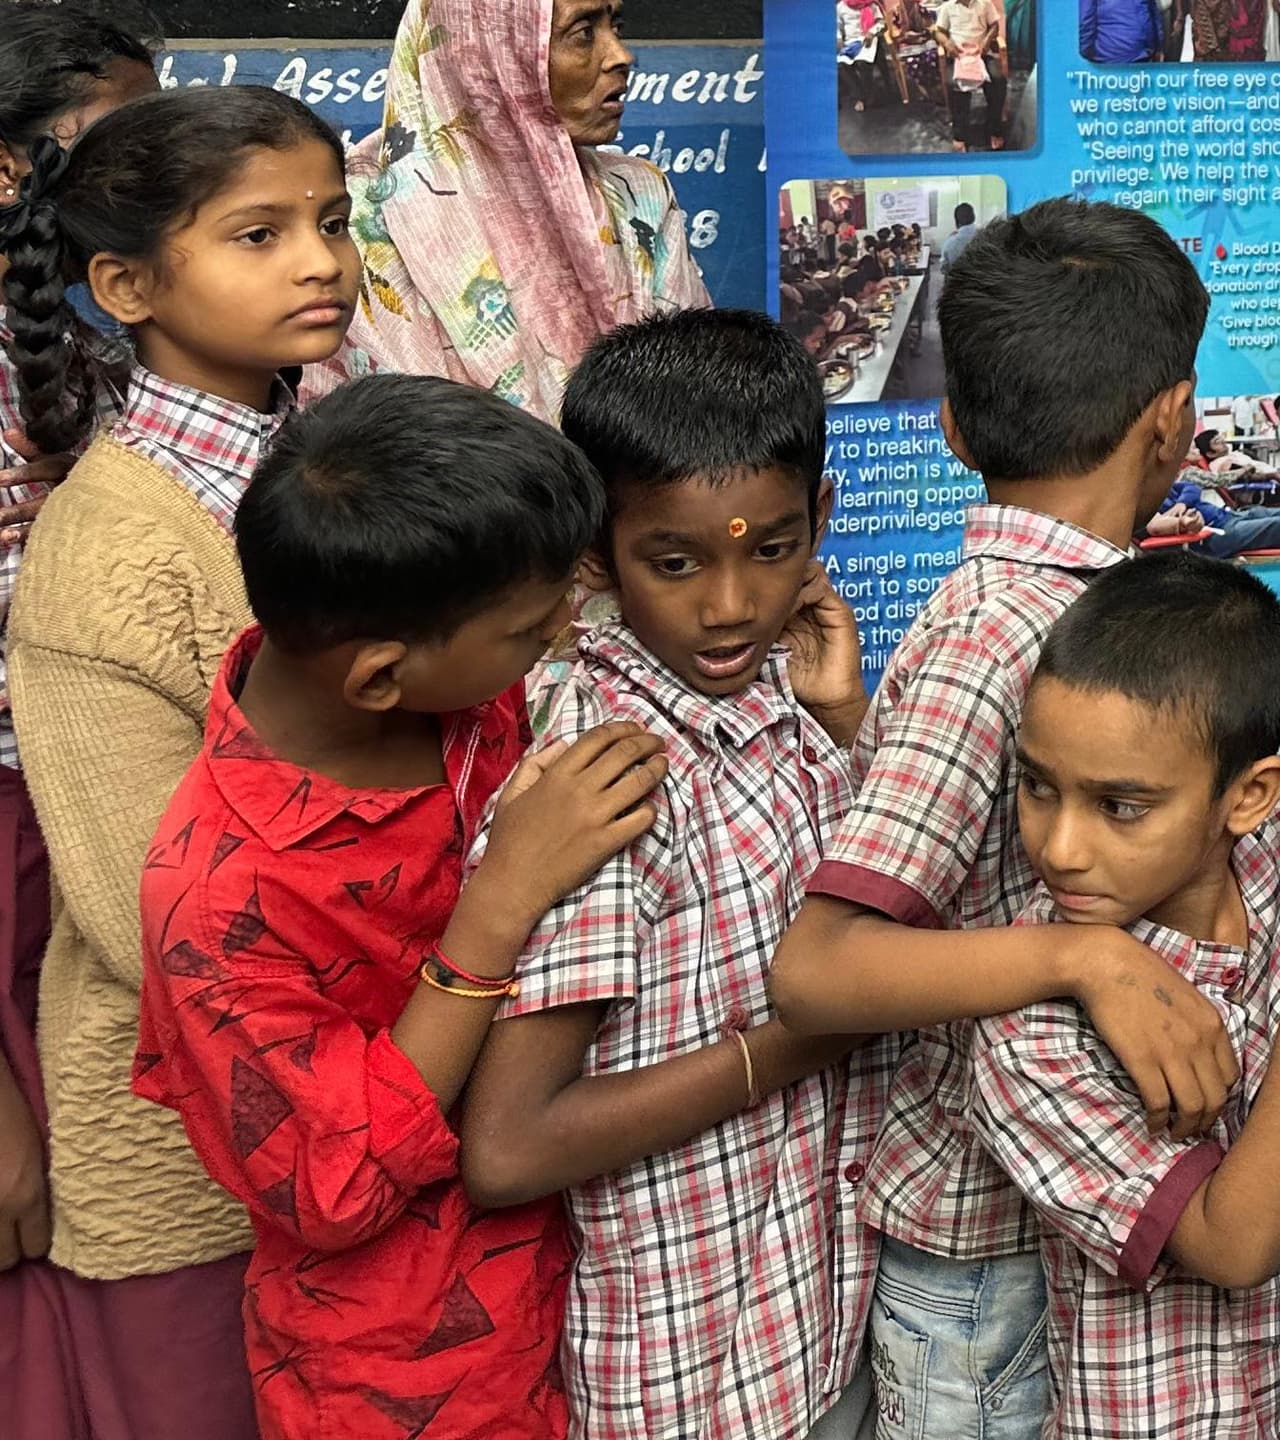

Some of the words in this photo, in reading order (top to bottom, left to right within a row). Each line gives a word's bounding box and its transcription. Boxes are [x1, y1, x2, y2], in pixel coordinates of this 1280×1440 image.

[1066, 71, 1151, 93] "Through
[1157, 74, 1187, 89] our
[1193, 70, 1229, 88] free
[1233, 74, 1267, 92] eye
[1071, 98, 1098, 113] we
[1104, 97, 1167, 113] restore
[1078, 119, 1118, 136] who
[1123, 118, 1186, 136] cannot
[1192, 116, 1245, 134] afford
[1083, 142, 1154, 162] "Seeing
[1161, 140, 1189, 157] the
[1195, 139, 1245, 157] world
[1071, 166, 1153, 187] privilege.
[1159, 163, 1190, 180] We
[1195, 163, 1234, 183] help
[1240, 161, 1269, 178] the
[1114, 188, 1169, 208] regain
[1175, 186, 1214, 204] their
[1222, 183, 1266, 206] sight
[1232, 242, 1270, 257] Blood
[1230, 298, 1259, 310] who
[1227, 334, 1277, 349] through
[898, 411, 936, 432] that
[839, 441, 860, 459] to
[866, 437, 952, 457] breaking
[859, 463, 918, 482] which
[924, 460, 941, 478] is
[837, 483, 918, 509] learning
[847, 550, 906, 576] single
[879, 577, 899, 595] to
